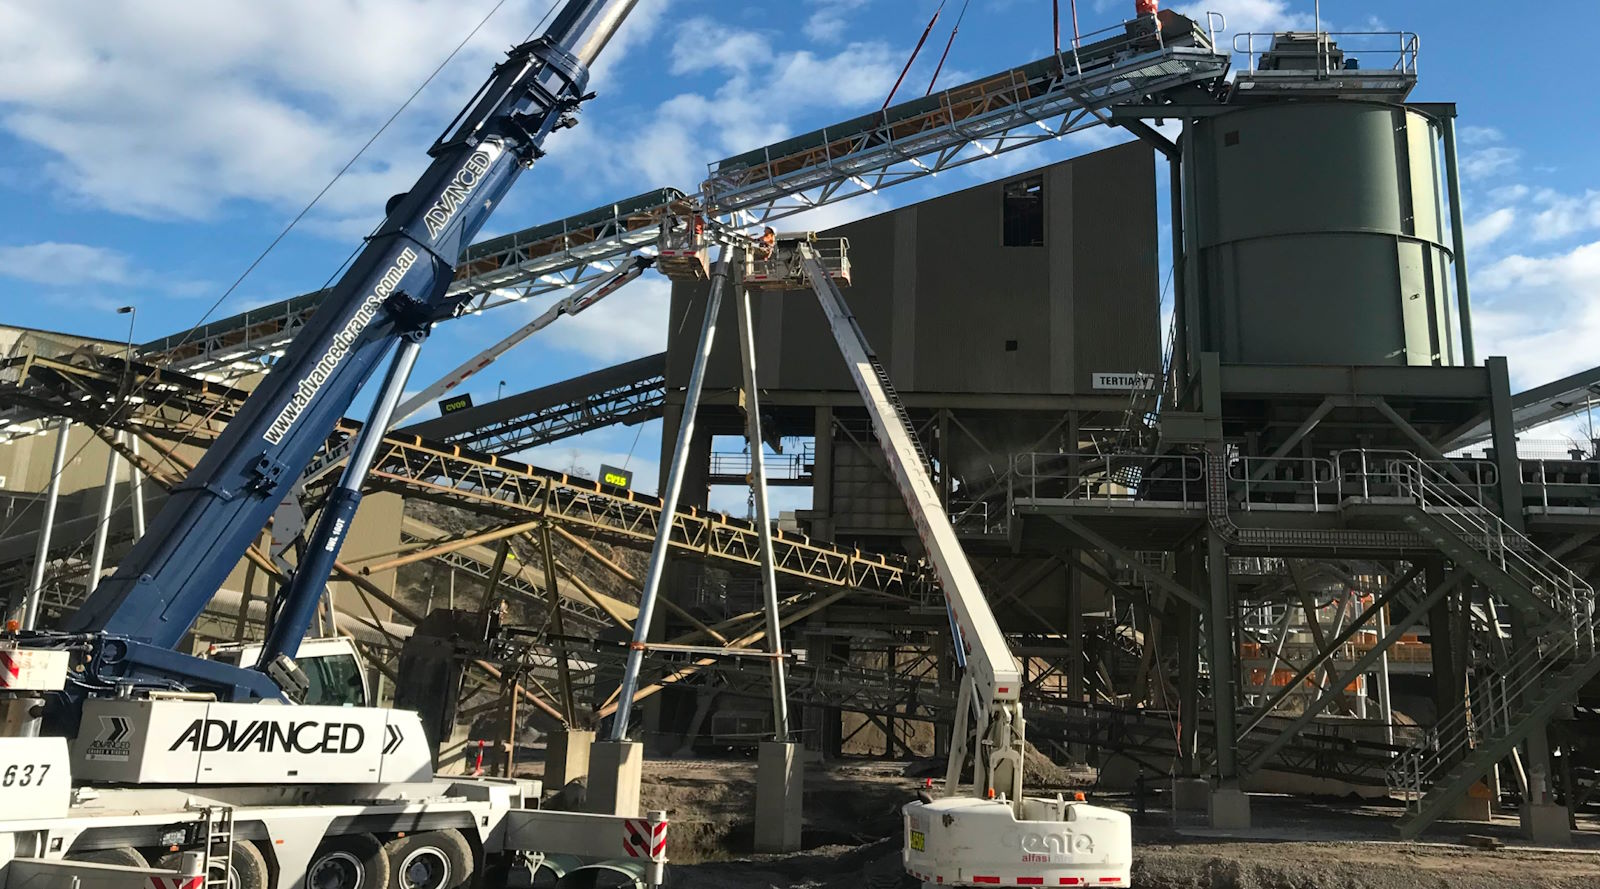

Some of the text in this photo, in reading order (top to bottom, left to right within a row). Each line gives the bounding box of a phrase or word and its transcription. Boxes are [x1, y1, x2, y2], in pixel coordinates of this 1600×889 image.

[424, 150, 491, 240] ADVANCED
[263, 247, 417, 445] www.advancedcranes.com.au
[446, 400, 466, 411] CV09
[303, 459, 323, 479] JLG
[605, 473, 626, 487] CV15
[325, 536, 339, 552] SWL
[168, 719, 365, 754] ADVANCED
[2, 764, 51, 787] 637
